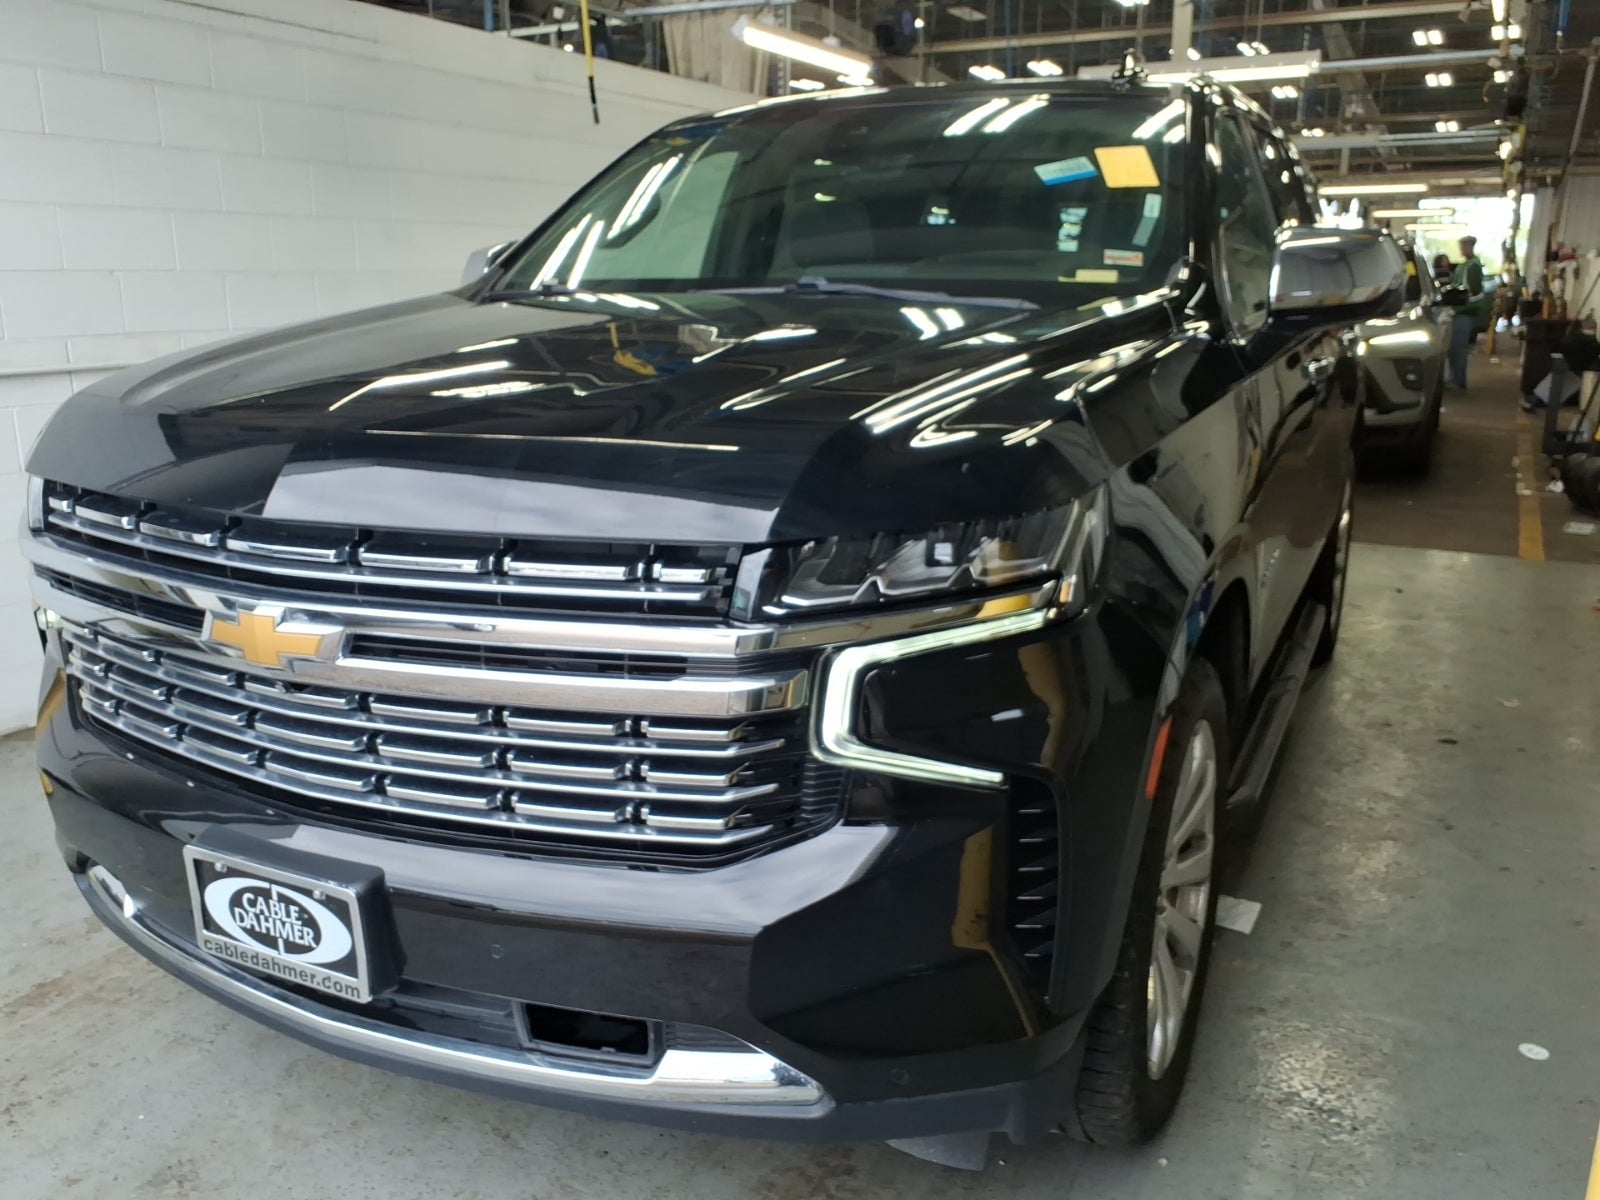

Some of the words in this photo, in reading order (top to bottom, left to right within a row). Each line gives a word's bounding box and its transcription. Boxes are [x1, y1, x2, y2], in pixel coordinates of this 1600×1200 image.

[234, 907, 317, 948] DAHMER
[242, 893, 302, 925] CABLE
[204, 939, 361, 999] cabledahmer.com
